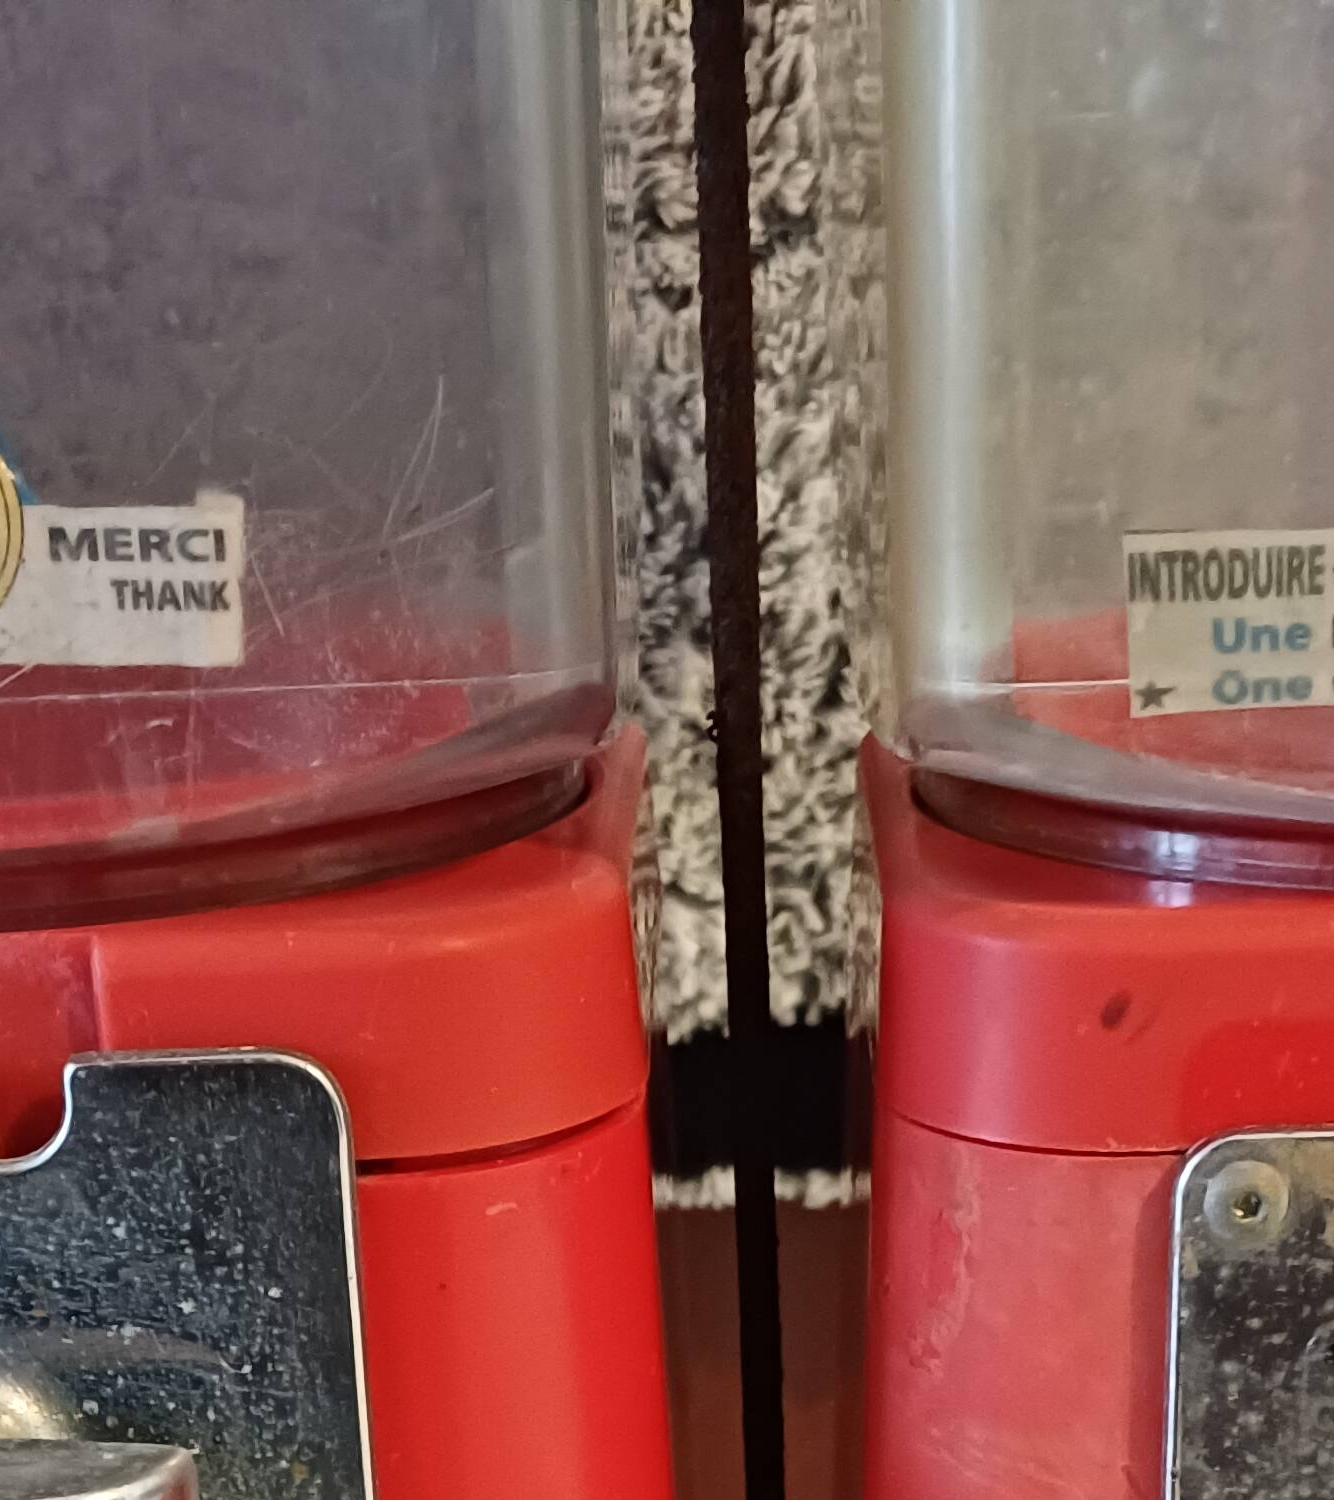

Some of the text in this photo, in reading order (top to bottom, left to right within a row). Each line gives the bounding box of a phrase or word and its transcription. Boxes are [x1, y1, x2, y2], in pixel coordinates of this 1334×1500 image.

[48, 526, 227, 564] MERCI
[1127, 544, 1326, 602] INTRODUIRE
[111, 577, 231, 612] THANK
[1212, 616, 1312, 654] Une
[1211, 670, 1313, 704] One
